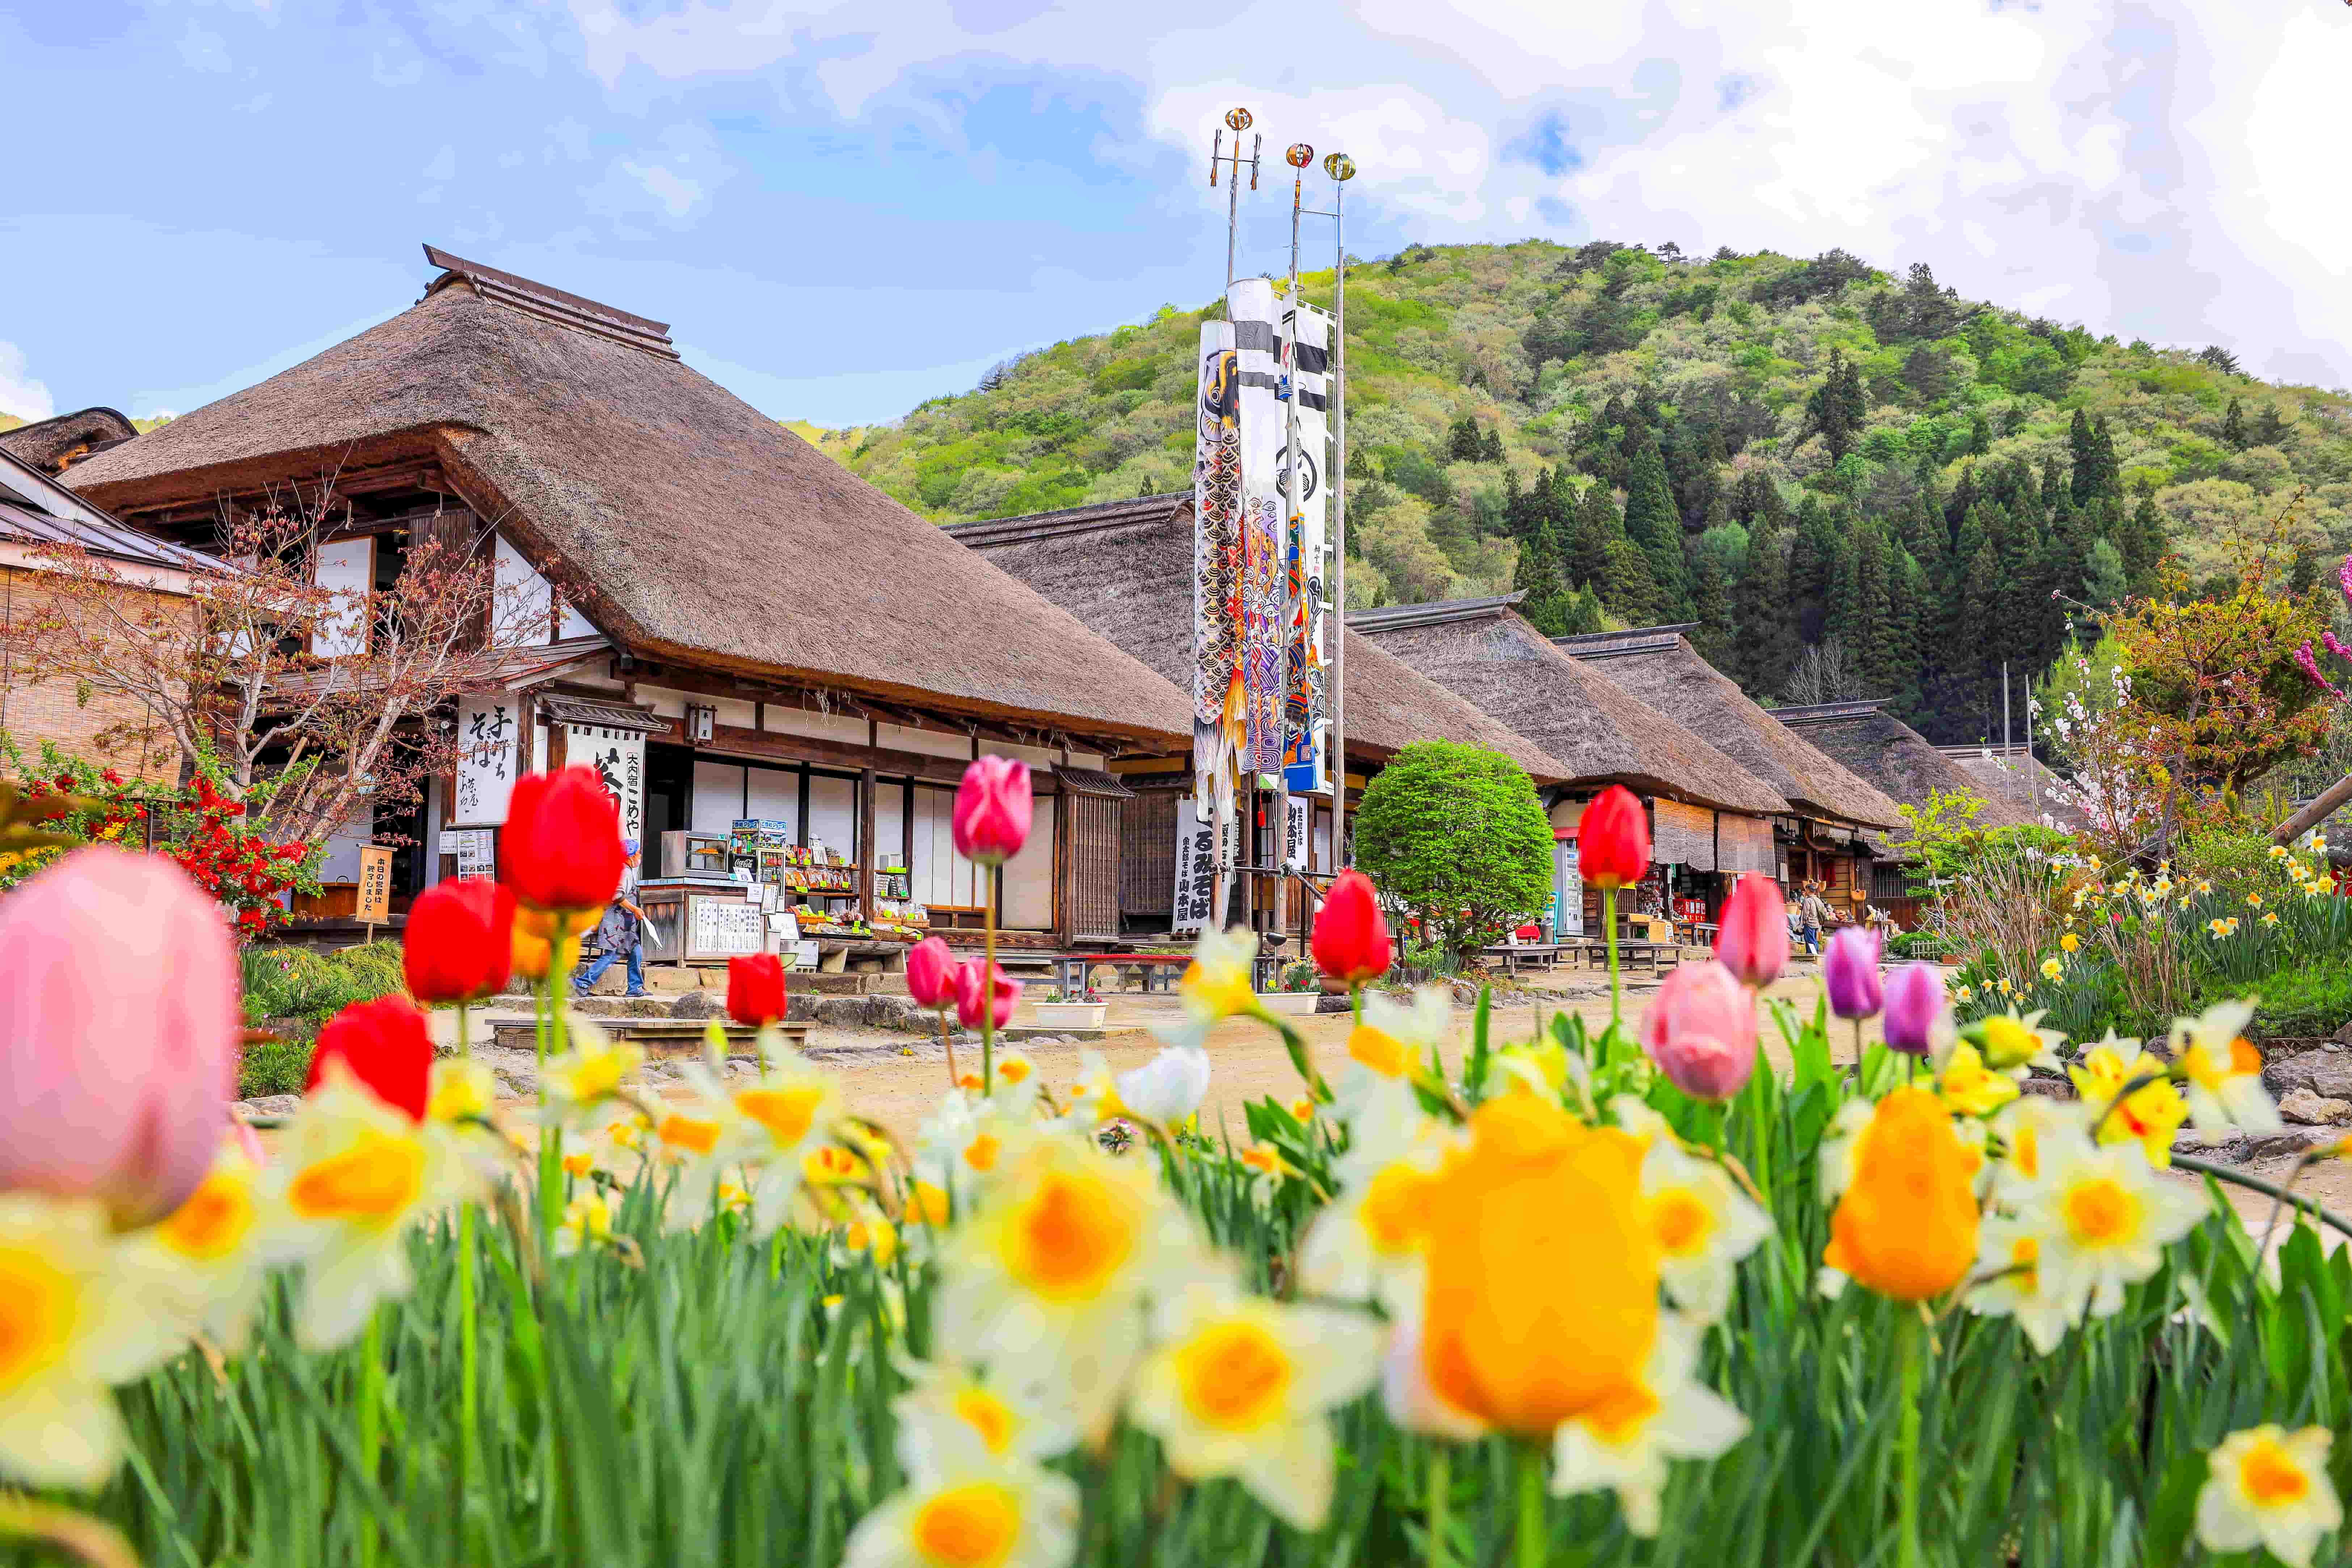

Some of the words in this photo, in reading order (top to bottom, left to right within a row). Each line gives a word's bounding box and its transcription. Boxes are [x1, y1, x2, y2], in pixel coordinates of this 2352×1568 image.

[364, 865, 375, 911] 終了しました
[375, 857, 385, 903] 本日の営業は
[1177, 880, 1190, 921] 山本屋
